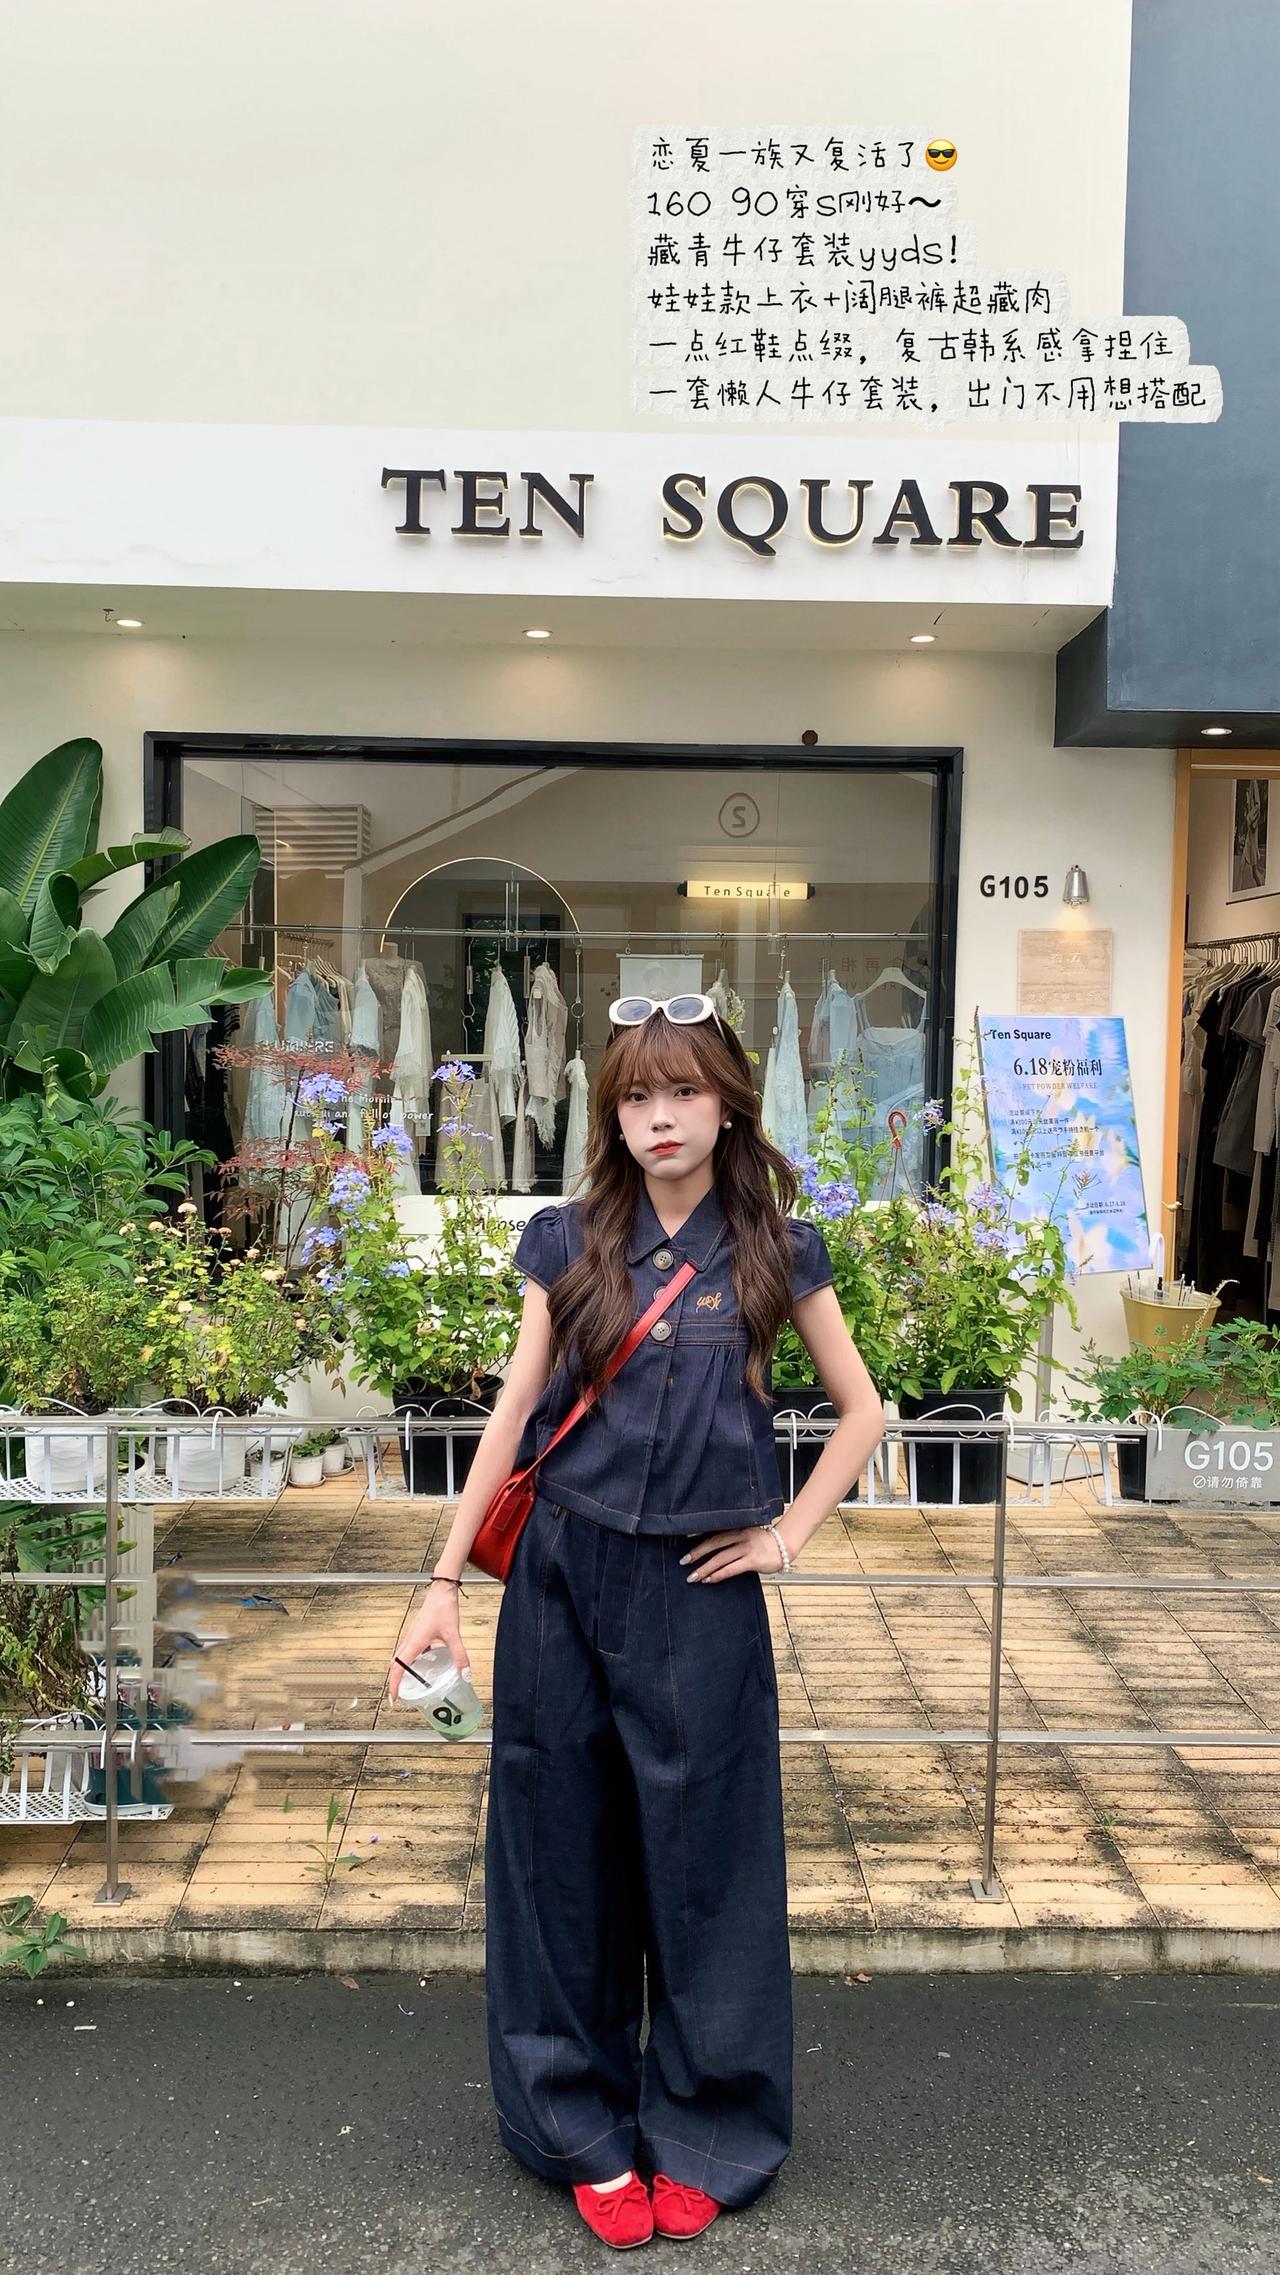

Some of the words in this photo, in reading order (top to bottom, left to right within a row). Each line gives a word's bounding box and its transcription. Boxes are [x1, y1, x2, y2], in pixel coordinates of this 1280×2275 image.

[381, 467, 595, 539] TEN
[662, 473, 1085, 557] SQUARE
[704, 886, 731, 897] Ten
[980, 874, 1049, 899] G105
[990, 1029, 1011, 1040] Ten
[1013, 1029, 1051, 1042] Square
[1013, 1057, 1103, 1077] 6.18宠粉福利
[1184, 1440, 1274, 1471] G105
[1206, 1475, 1263, 1489] 请勿倚靠
